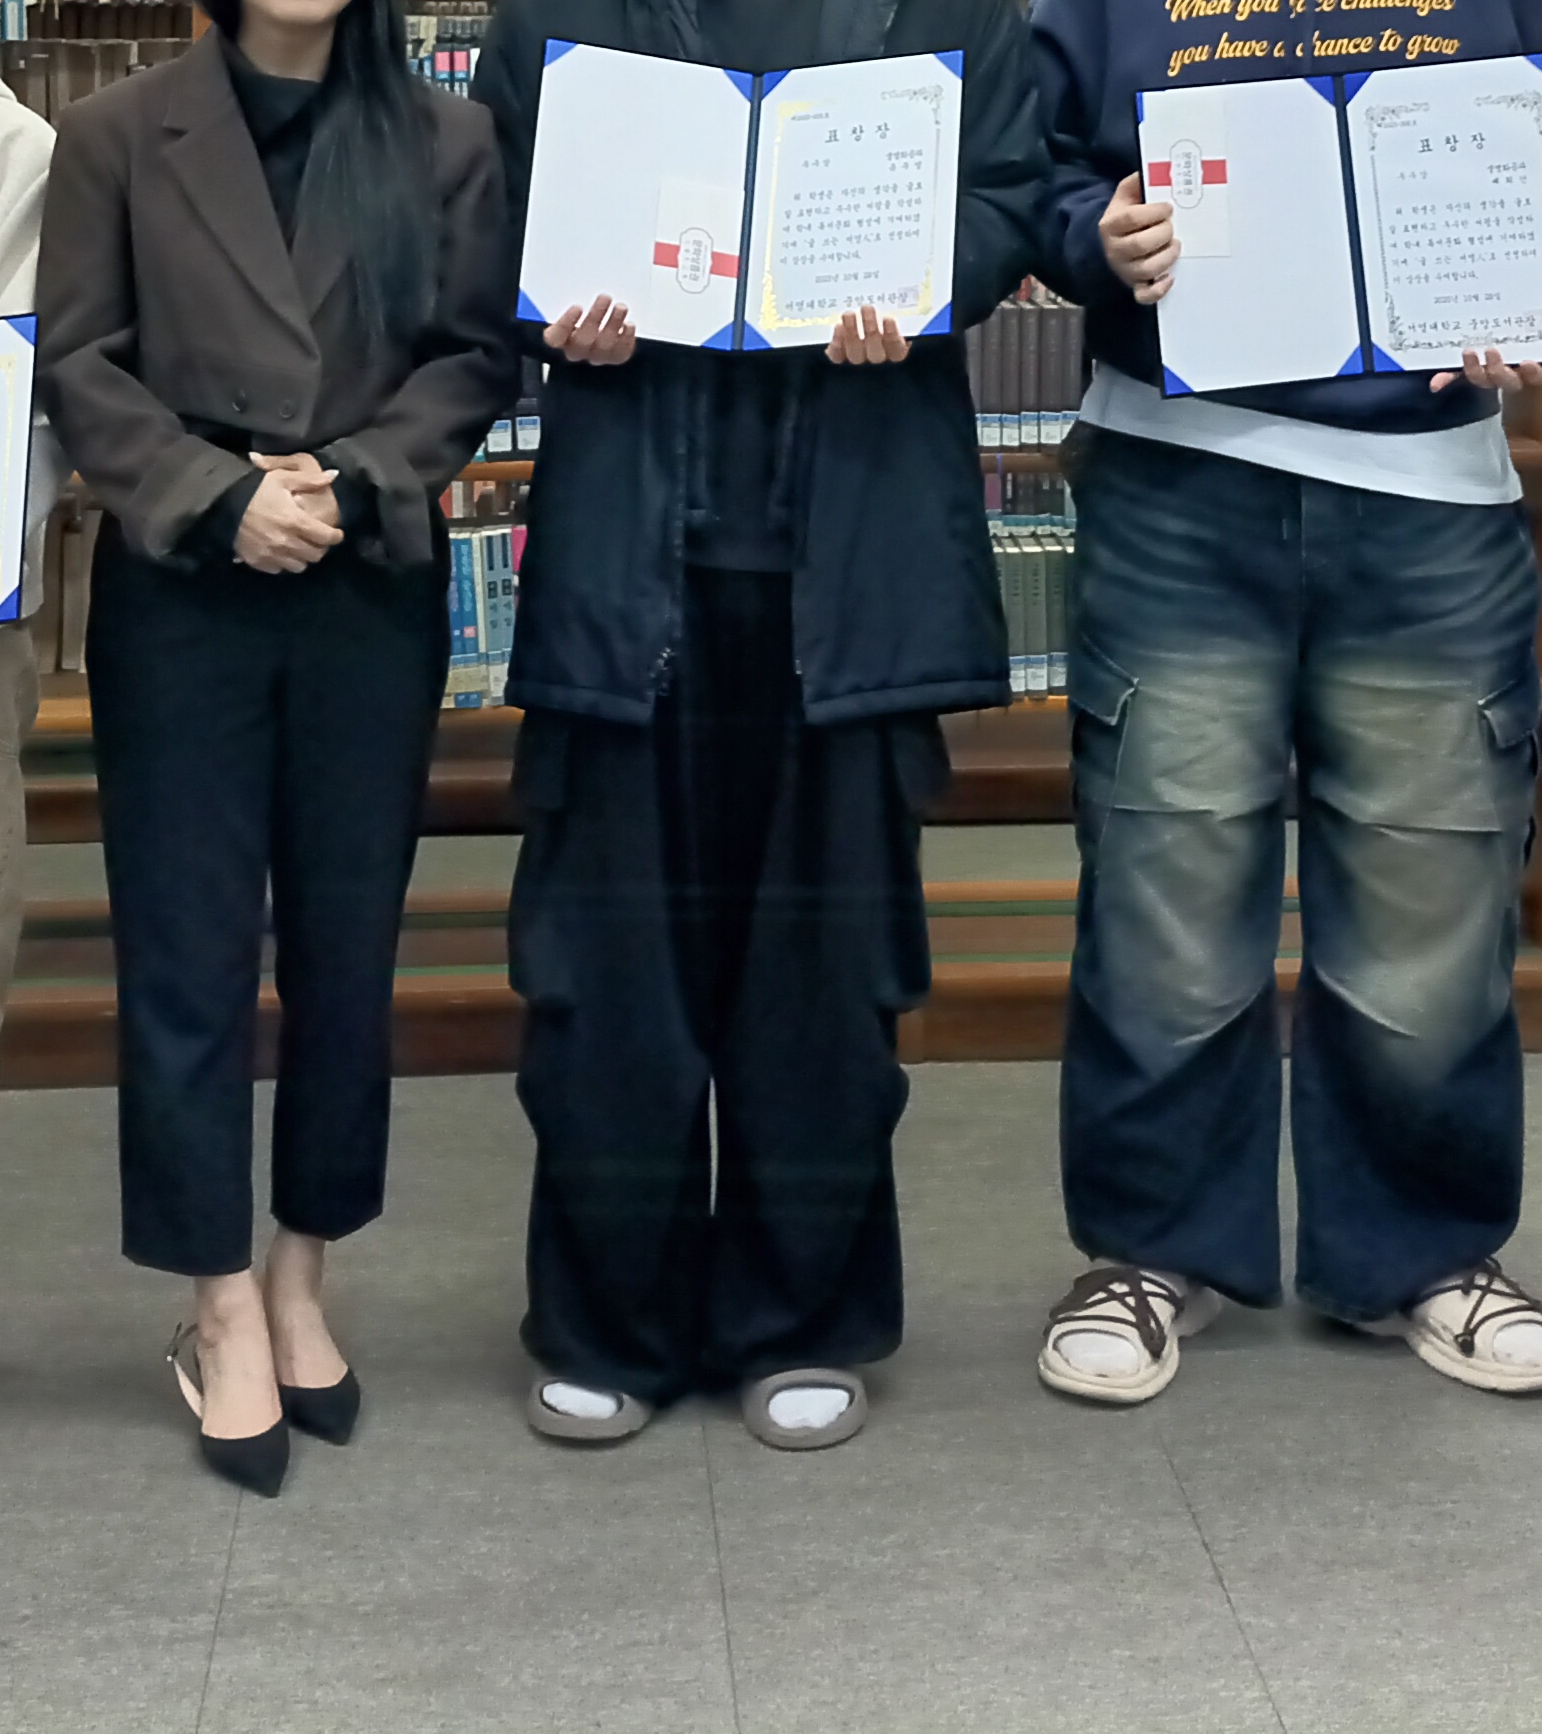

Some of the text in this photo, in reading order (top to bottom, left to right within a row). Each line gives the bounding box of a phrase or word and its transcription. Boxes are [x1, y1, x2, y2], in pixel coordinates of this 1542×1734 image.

[1167, 44, 1210, 77] you
[1214, 31, 1269, 60] have
[1379, 27, 1404, 52] to
[1405, 34, 1462, 60] grow
